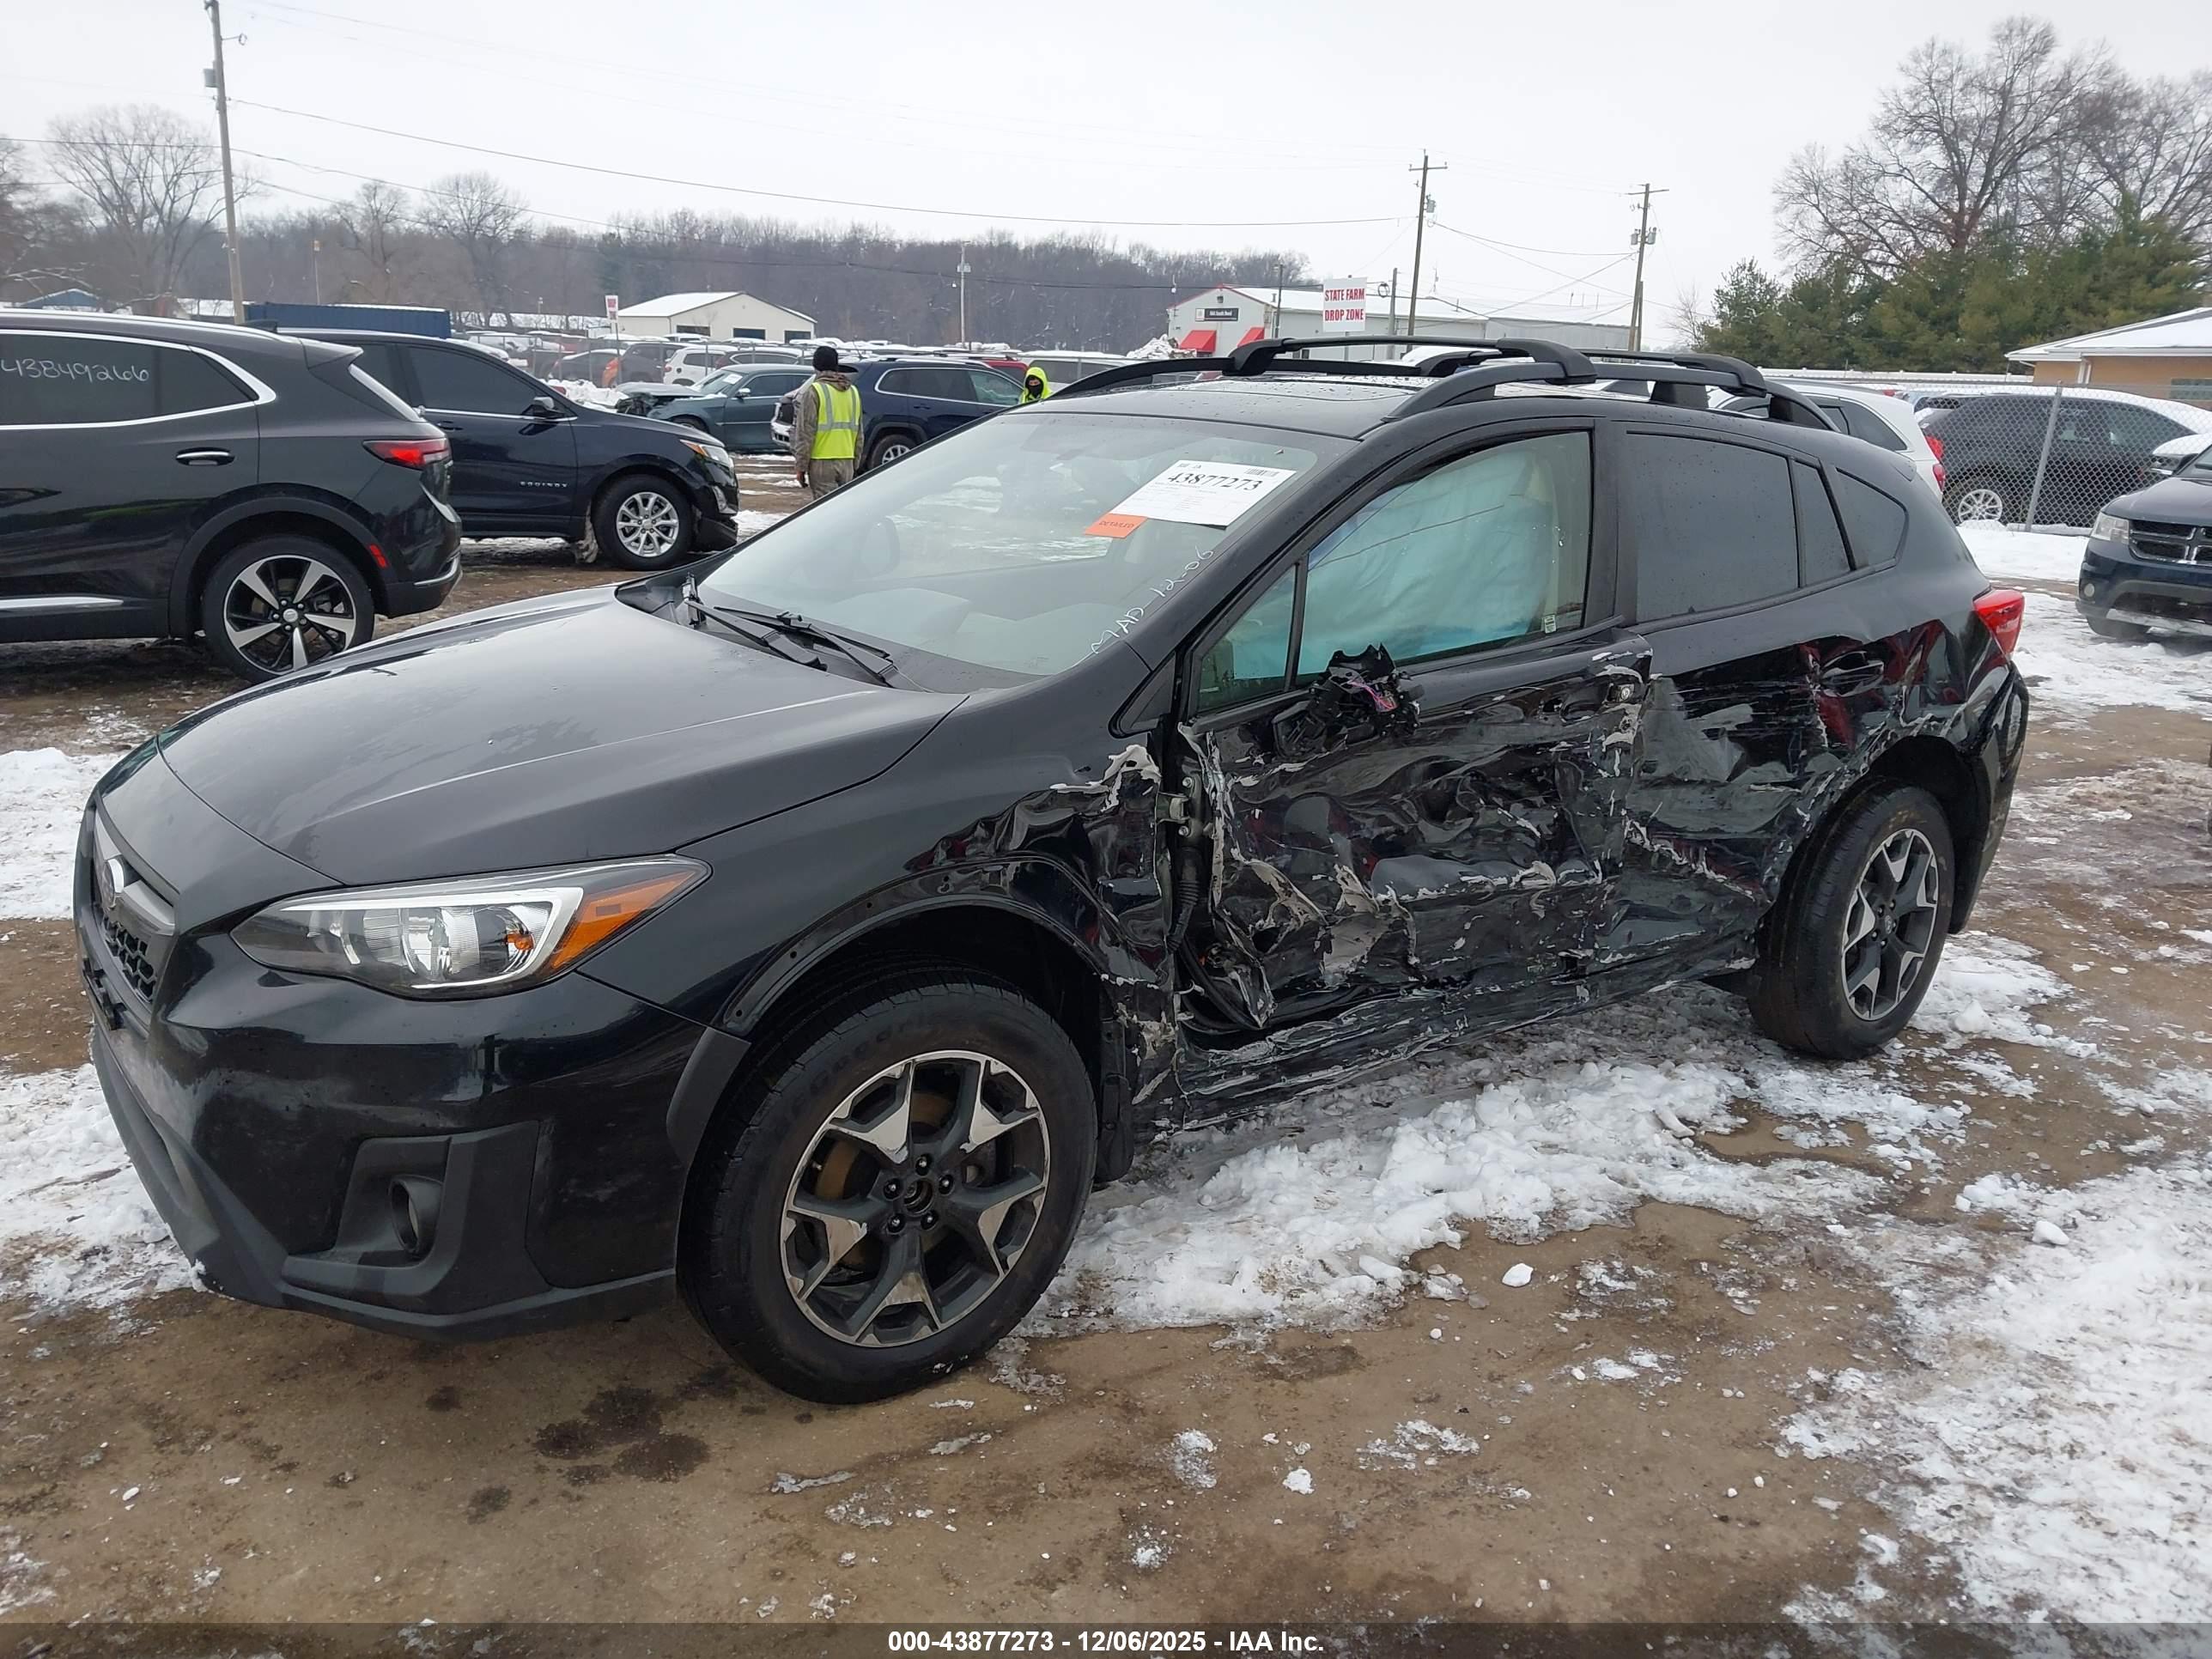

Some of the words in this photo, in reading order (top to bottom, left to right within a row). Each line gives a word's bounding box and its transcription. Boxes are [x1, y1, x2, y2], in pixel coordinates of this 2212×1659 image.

[1325, 289, 1345, 301] STATE
[1346, 288, 1365, 301] FARM
[1325, 309, 1345, 321] DROP
[1346, 308, 1364, 320] ZONE
[1, 358, 149, 382] 43849266
[1168, 472, 1263, 491] 43877273
